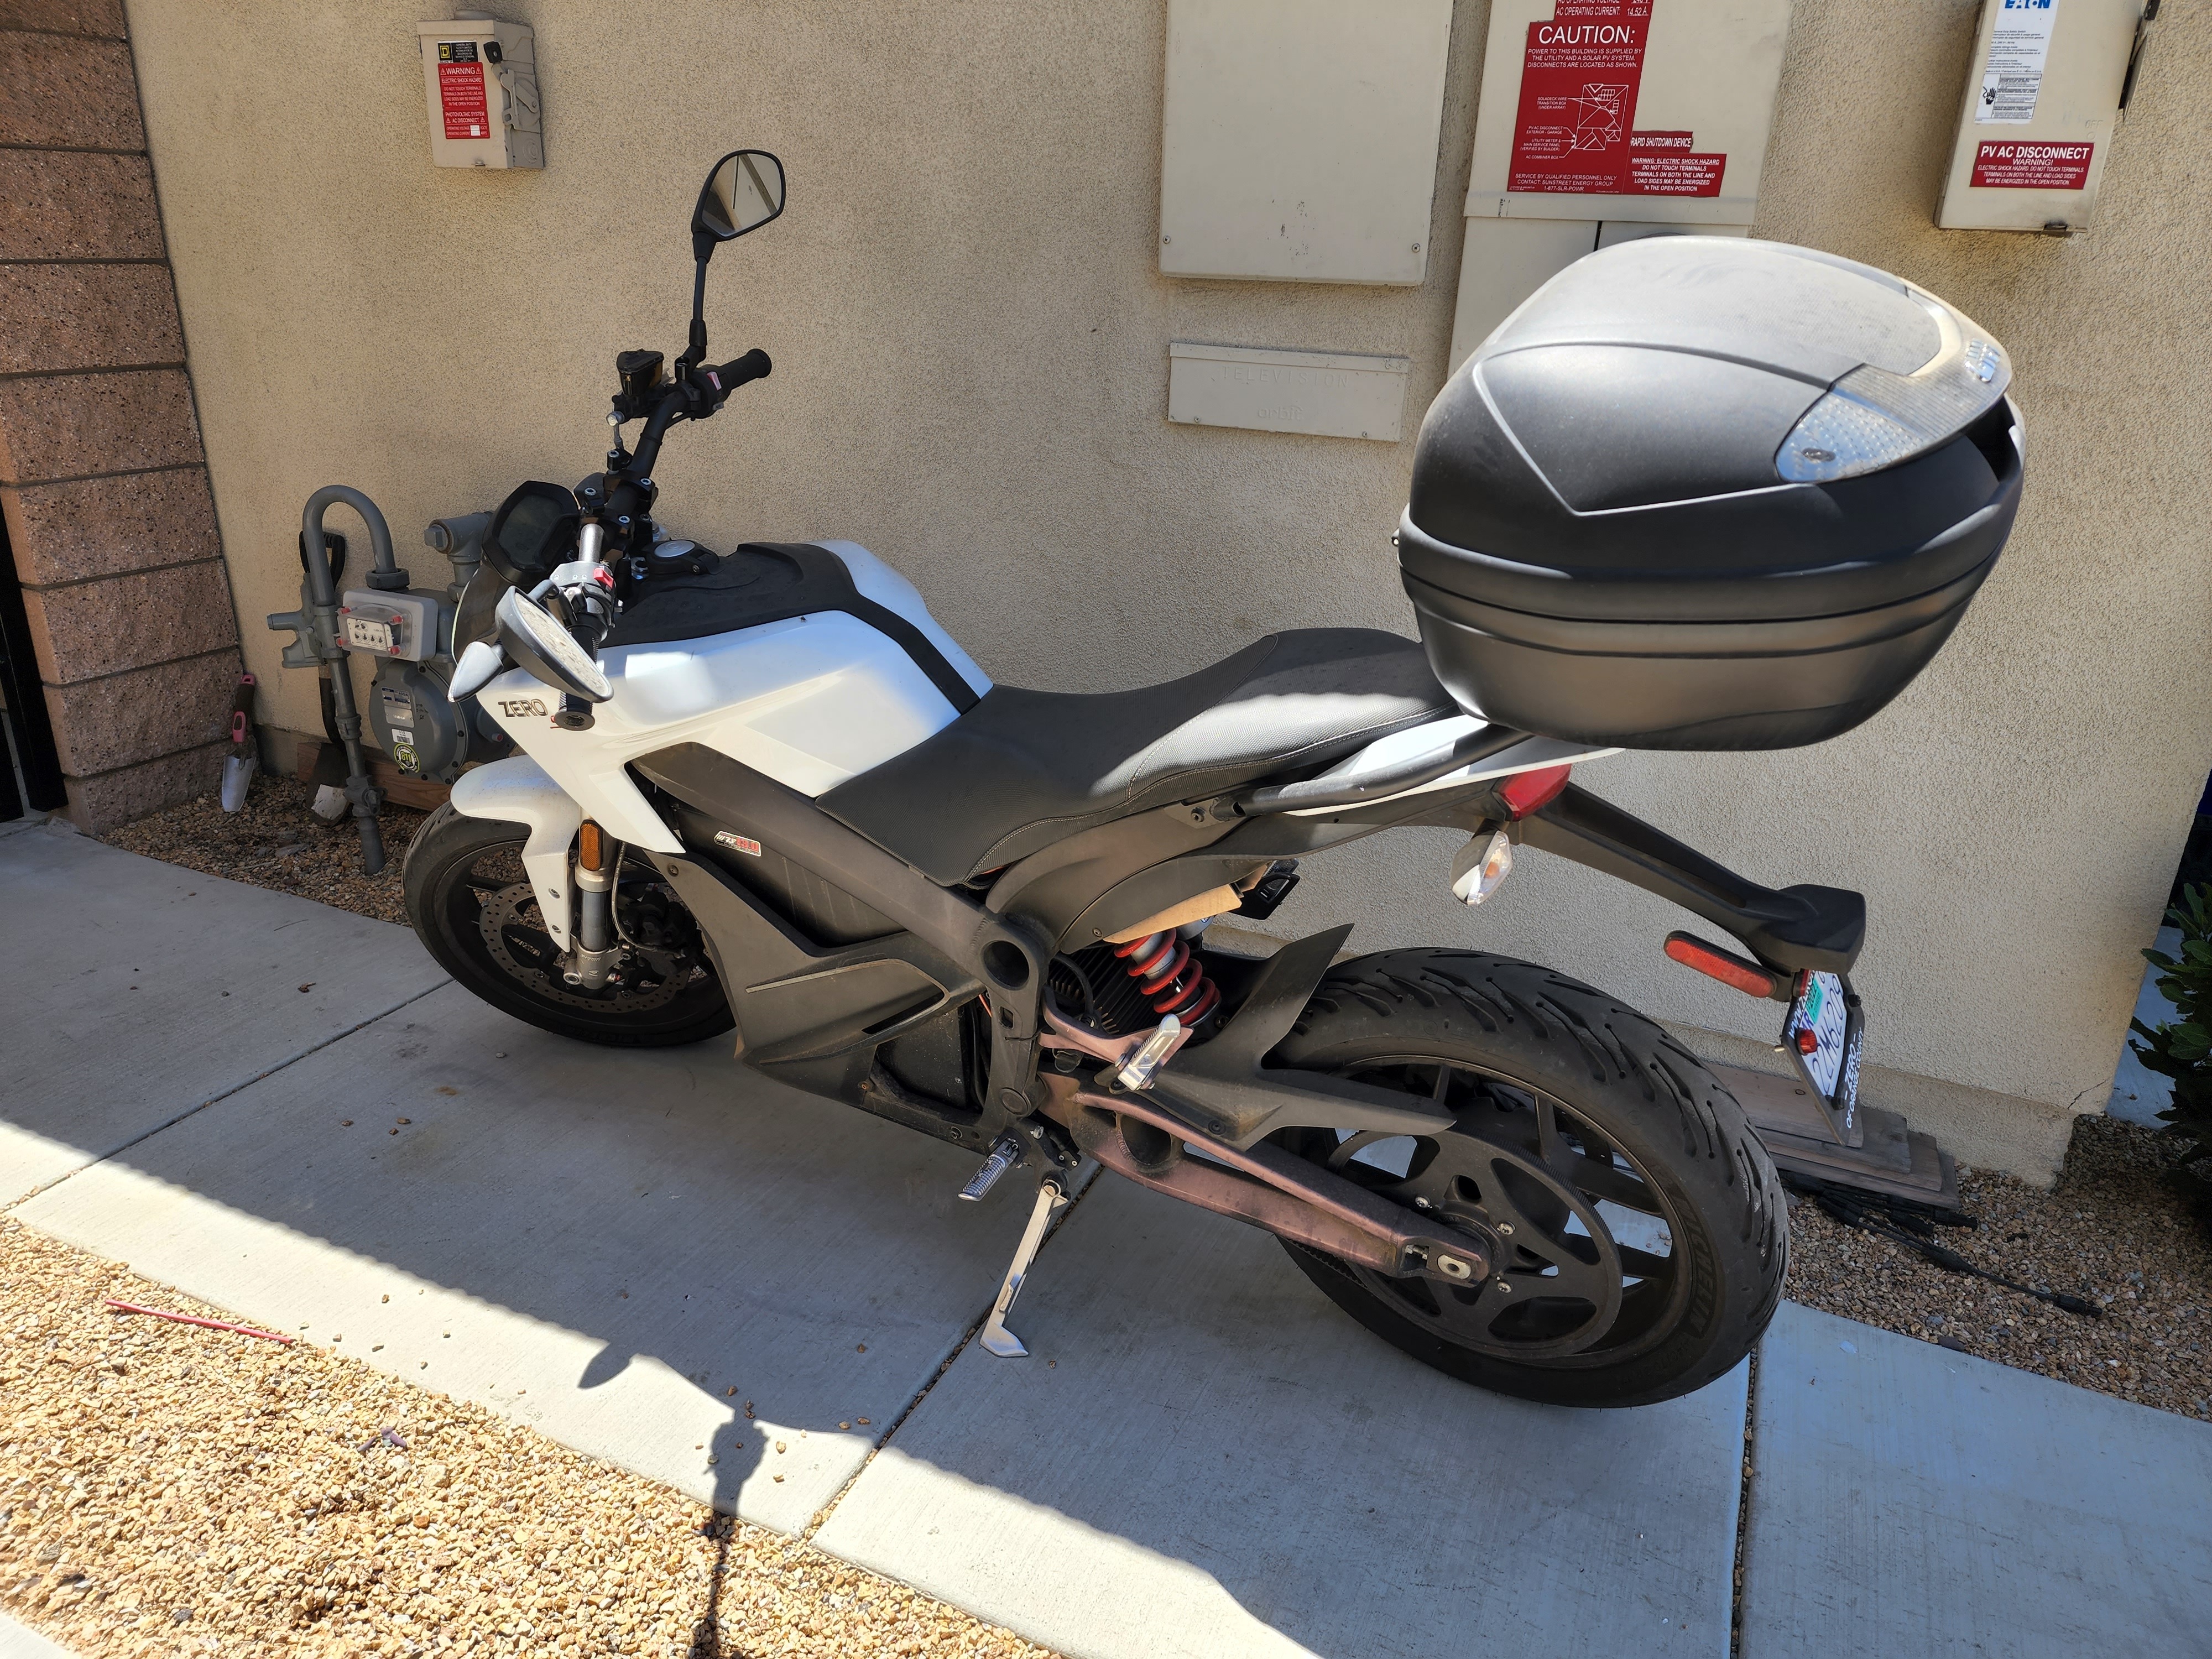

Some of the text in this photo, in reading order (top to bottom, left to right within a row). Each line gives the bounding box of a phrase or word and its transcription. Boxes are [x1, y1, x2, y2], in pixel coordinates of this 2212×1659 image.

[1564, 7, 1593, 15] OPERATING
[1594, 7, 1620, 15] CURRENT:
[1627, 7, 1641, 16] 14.52
[1642, 7, 1647, 15] A
[1539, 25, 1635, 44] CAUTION:
[1631, 137, 1692, 147] RAPID SHUTDOWN DEVICE
[1981, 145, 2090, 159] PV AC DISCONNECT
[1222, 366, 1349, 388] TELEVISION
[498, 698, 549, 717] ZERO
[400, 750, 412, 763] 811
[1812, 975, 1843, 1094] 22M6209
[1845, 1043, 1856, 1091] ZERO
[1846, 1026, 1864, 1129] OF ORANGE COUNTY
[1673, 1196, 1714, 1333] MICHELIN
